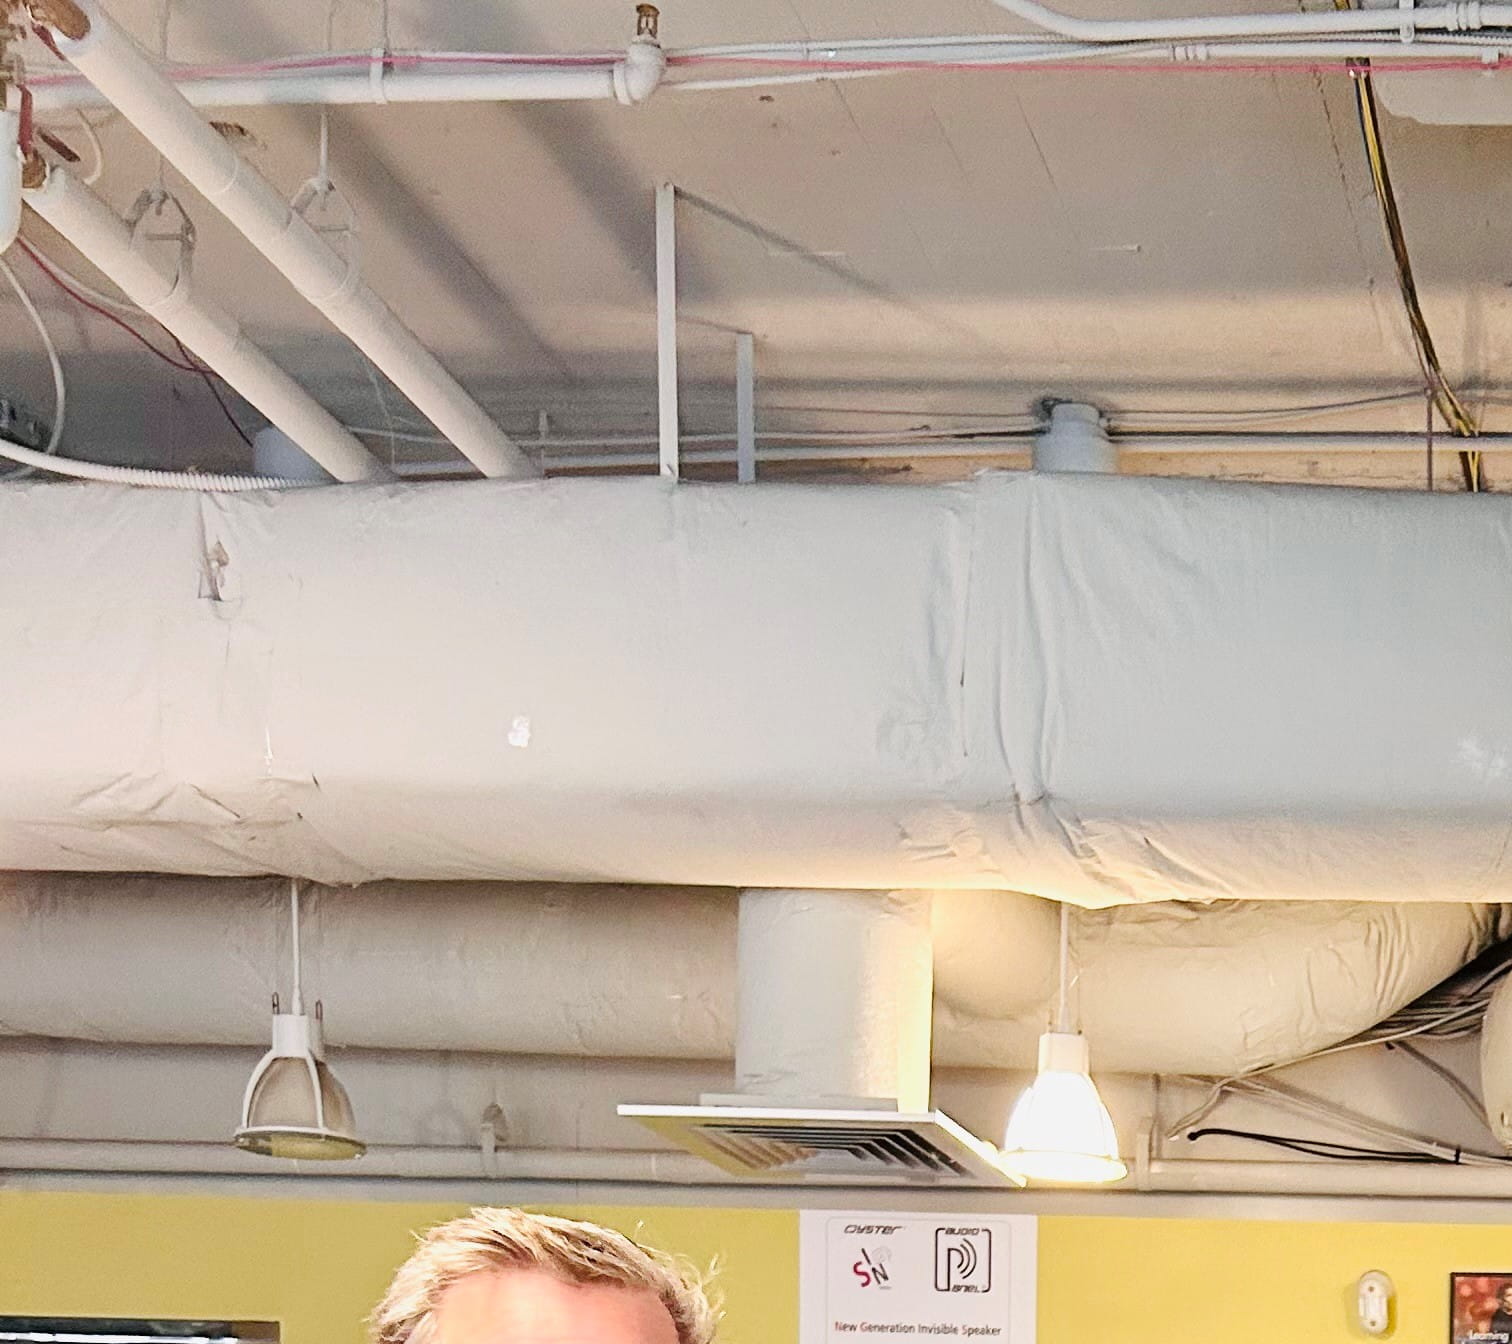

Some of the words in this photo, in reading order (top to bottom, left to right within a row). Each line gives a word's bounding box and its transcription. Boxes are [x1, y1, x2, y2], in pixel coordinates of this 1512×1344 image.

[834, 1321, 858, 1333] New
[860, 1322, 916, 1335] Generation
[918, 1323, 959, 1335] Invisible
[962, 1325, 1002, 1337] Speaker
[1469, 1330, 1509, 1343] Learning
